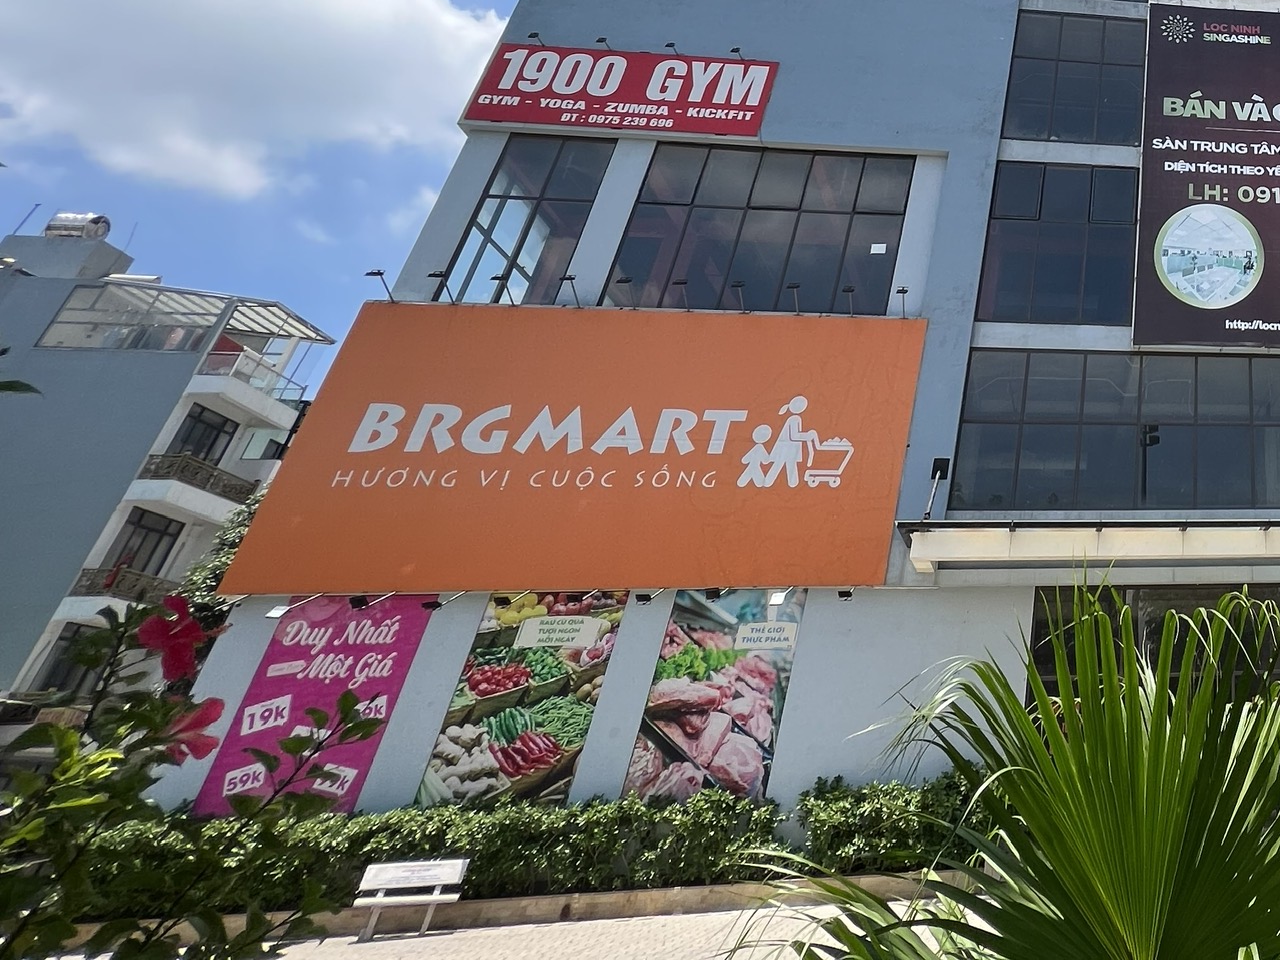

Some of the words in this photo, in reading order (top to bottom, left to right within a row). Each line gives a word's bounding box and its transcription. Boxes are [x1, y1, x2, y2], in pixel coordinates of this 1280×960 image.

[1203, 33, 1271, 45] SINGASHINE
[1230, 25, 1261, 34] NINH
[497, 48, 628, 97] 1900
[645, 59, 770, 106] GYM
[477, 94, 520, 106] GYM
[539, 98, 586, 111] YOGA
[605, 102, 669, 116] ZUMBA
[686, 107, 755, 121] KICKFIT
[1163, 90, 1226, 120] BÁN
[1232, 94, 1271, 123] VÀ
[588, 114, 620, 125] 0975
[622, 115, 647, 127] 239
[649, 117, 674, 128] 696
[1152, 137, 1187, 151] SÀN
[1190, 140, 1248, 155] TRUNG
[1164, 160, 1196, 175] DIỆN
[1197, 161, 1230, 175] TÍCH
[1229, 165, 1264, 176] THEO
[1188, 183, 1229, 202] LH:
[347, 402, 748, 456] BRGMART
[331, 466, 458, 488] HƯƠNG
[480, 468, 511, 492] VỊ
[529, 465, 617, 491] CUỘC
[634, 463, 717, 488] SỐNG
[282, 620, 333, 654] Duy
[333, 615, 401, 647] Nhất
[297, 653, 353, 684] Một
[348, 652, 398, 690] Giá
